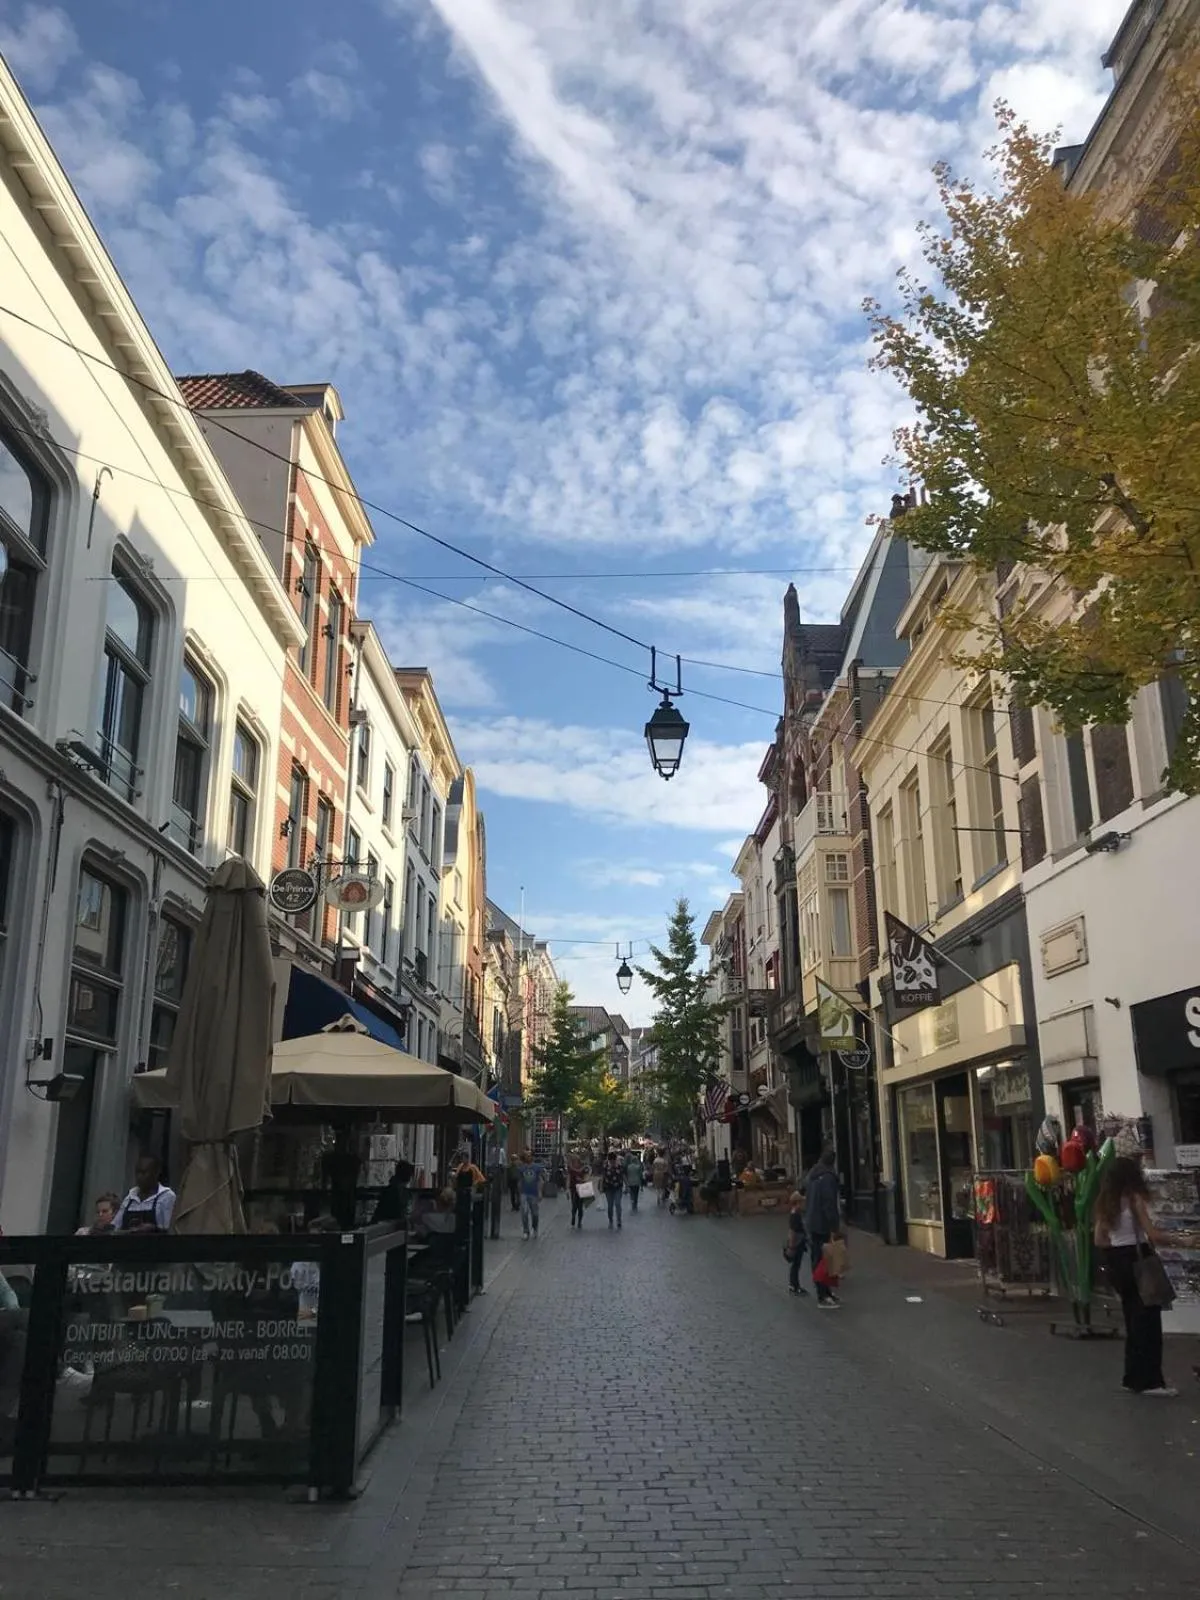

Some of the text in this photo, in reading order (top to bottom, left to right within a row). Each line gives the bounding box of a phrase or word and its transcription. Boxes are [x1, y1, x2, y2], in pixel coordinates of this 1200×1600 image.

[286, 882, 314, 893] Prince
[900, 992, 934, 1003] KOFFIE
[71, 1267, 194, 1294] Restaurant
[138, 1321, 188, 1341] LUNCH
[200, 1320, 245, 1340] DINER
[257, 1319, 312, 1338] BORREL
[118, 1346, 150, 1362] vanaf
[238, 1344, 271, 1361] vanaf
